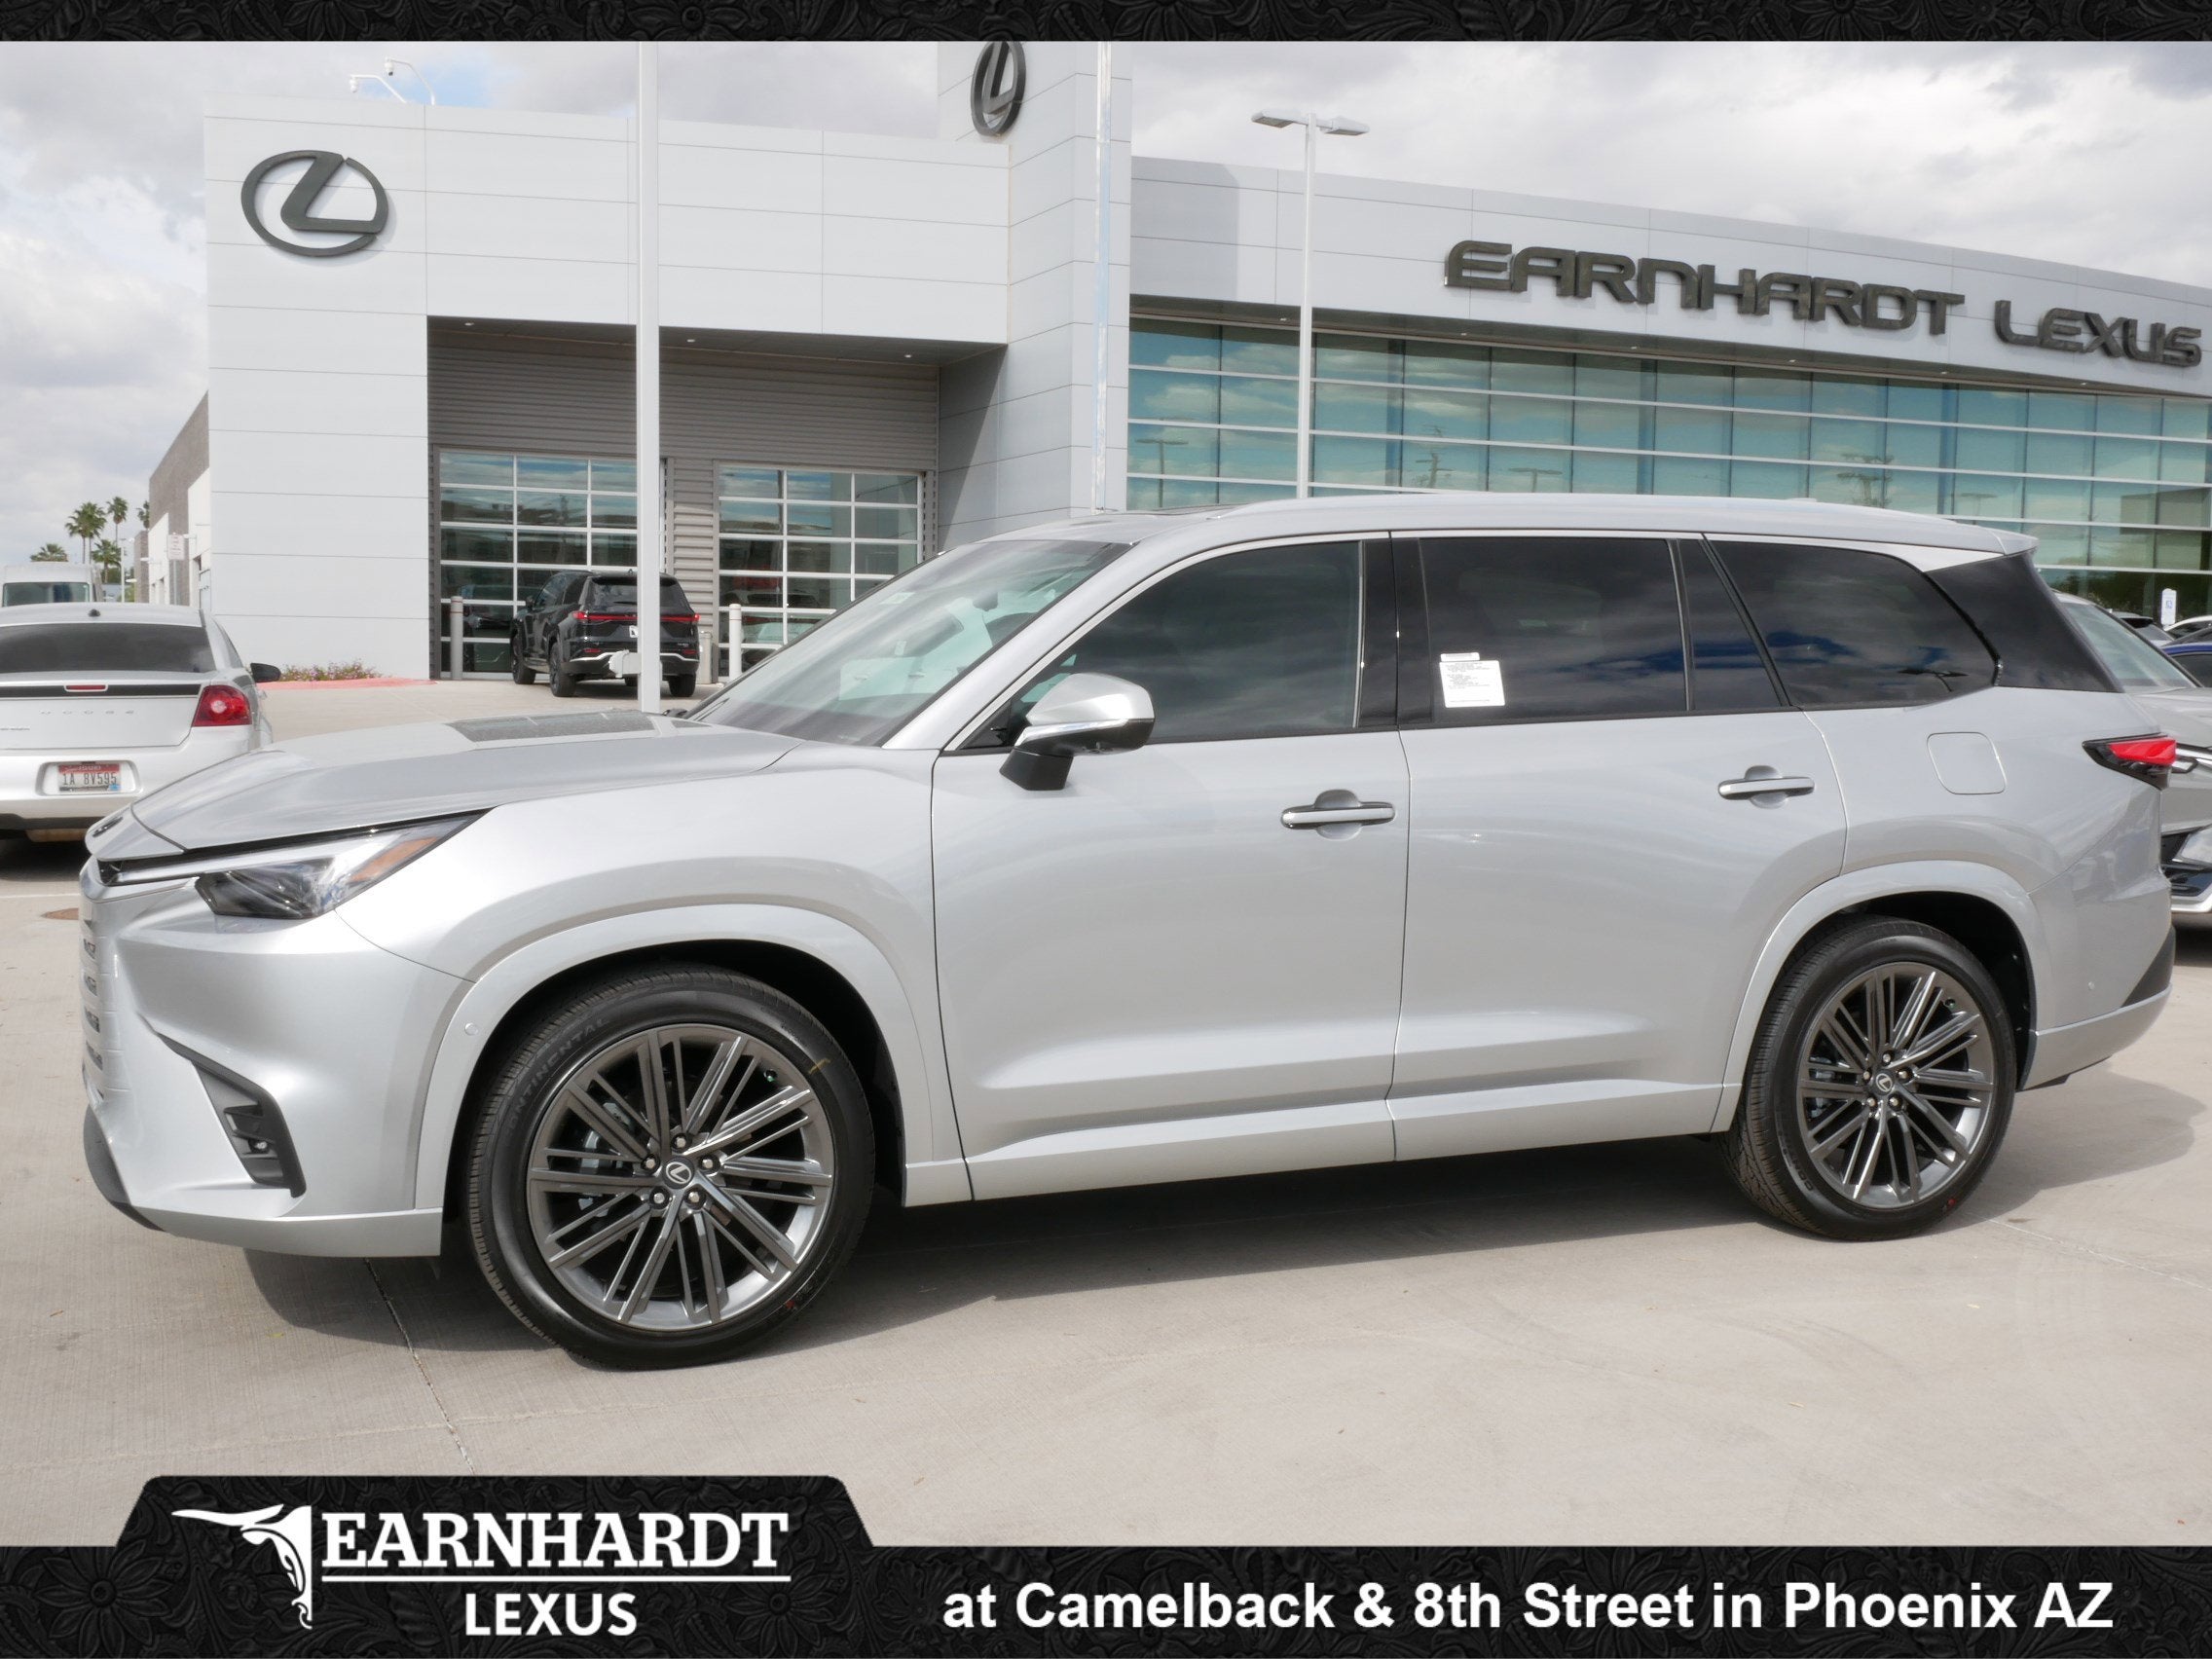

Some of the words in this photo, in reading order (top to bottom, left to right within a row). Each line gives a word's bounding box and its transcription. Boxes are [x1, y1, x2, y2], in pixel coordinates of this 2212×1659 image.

[1445, 240, 1965, 335] EARNHARDT
[1994, 300, 2202, 367] LEXUS
[504, 1016, 608, 1135] ONTINENTAL
